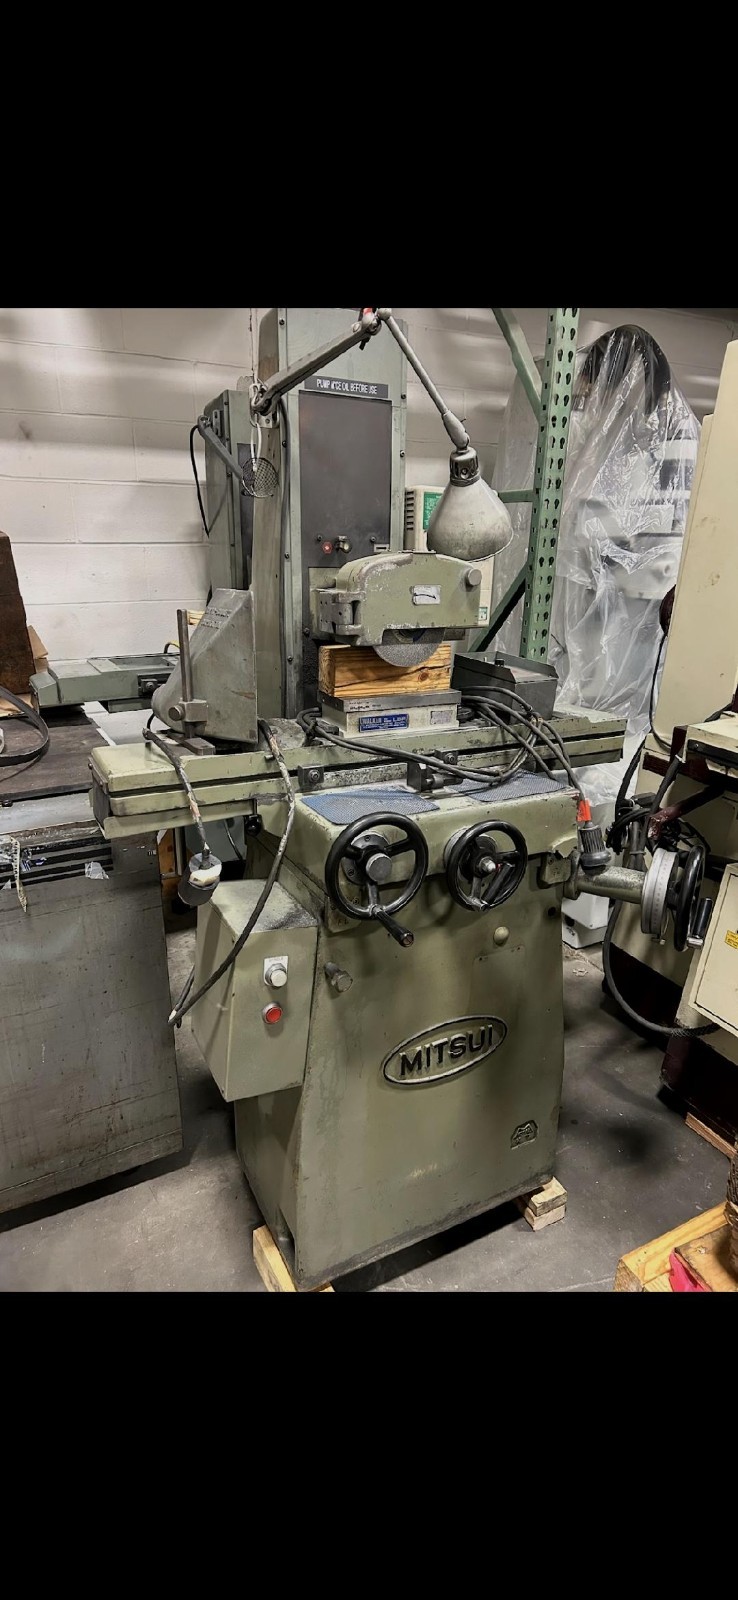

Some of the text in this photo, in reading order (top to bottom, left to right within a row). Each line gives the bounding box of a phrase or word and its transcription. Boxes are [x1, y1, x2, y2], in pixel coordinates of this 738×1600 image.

[316, 378, 330, 388] PUMP
[350, 383, 368, 394] BEFORE
[399, 1024, 493, 1078] MITSUI
